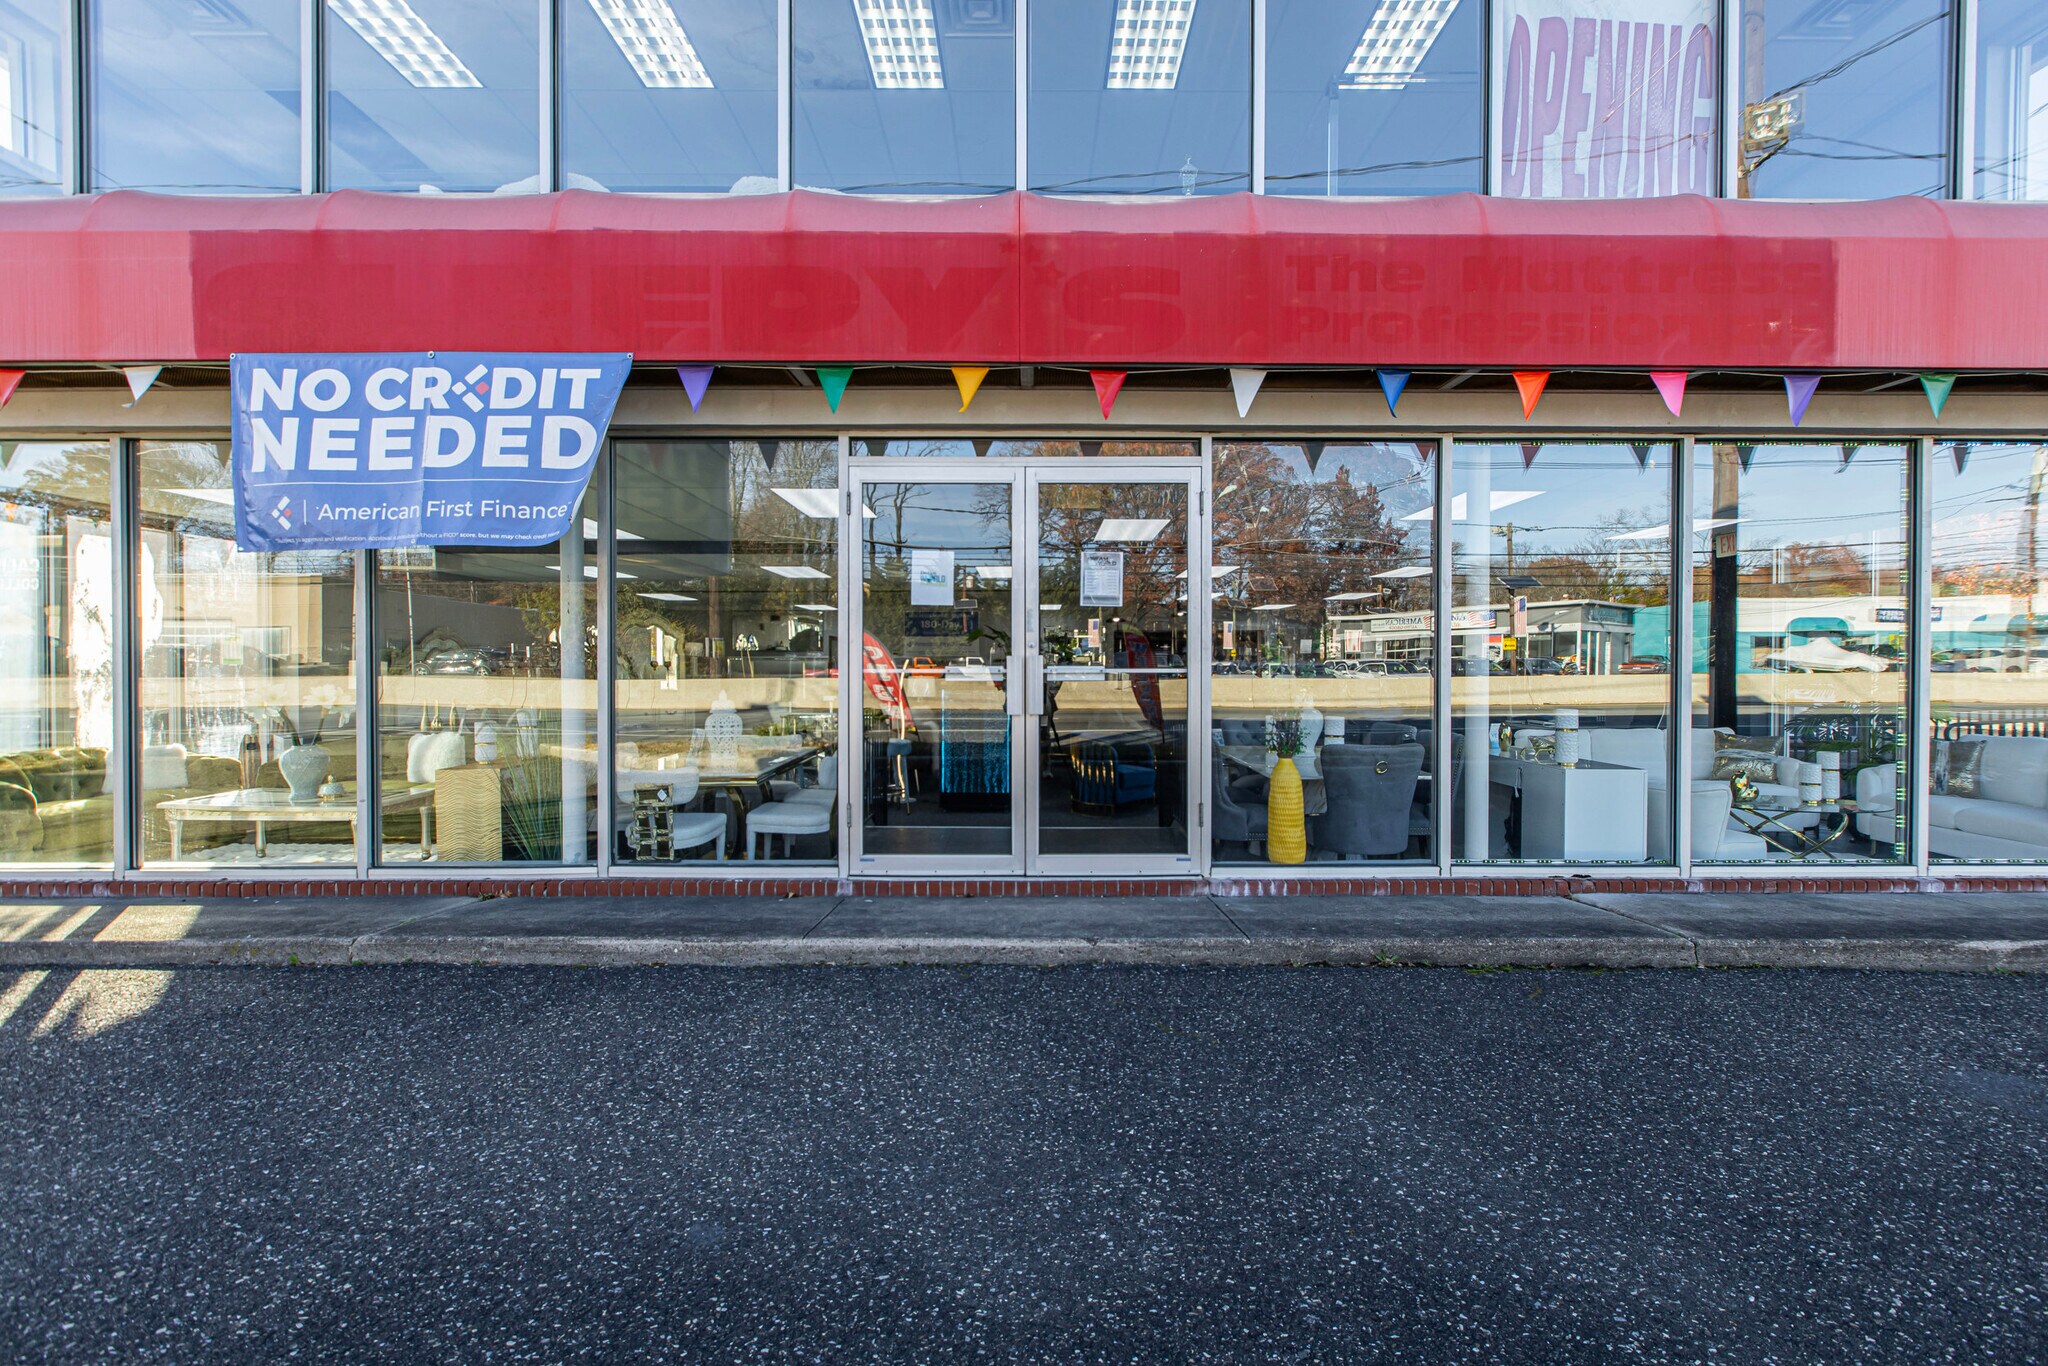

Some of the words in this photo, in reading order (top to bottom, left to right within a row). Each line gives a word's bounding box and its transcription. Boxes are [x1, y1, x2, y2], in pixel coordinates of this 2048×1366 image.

[1501, 14, 1713, 198] OPENING
[1285, 254, 1425, 293] The
[1462, 254, 1825, 295] Mattress
[250, 367, 351, 412] NO
[250, 414, 598, 473] NEEDED
[317, 502, 420, 521] American
[426, 499, 473, 518] First
